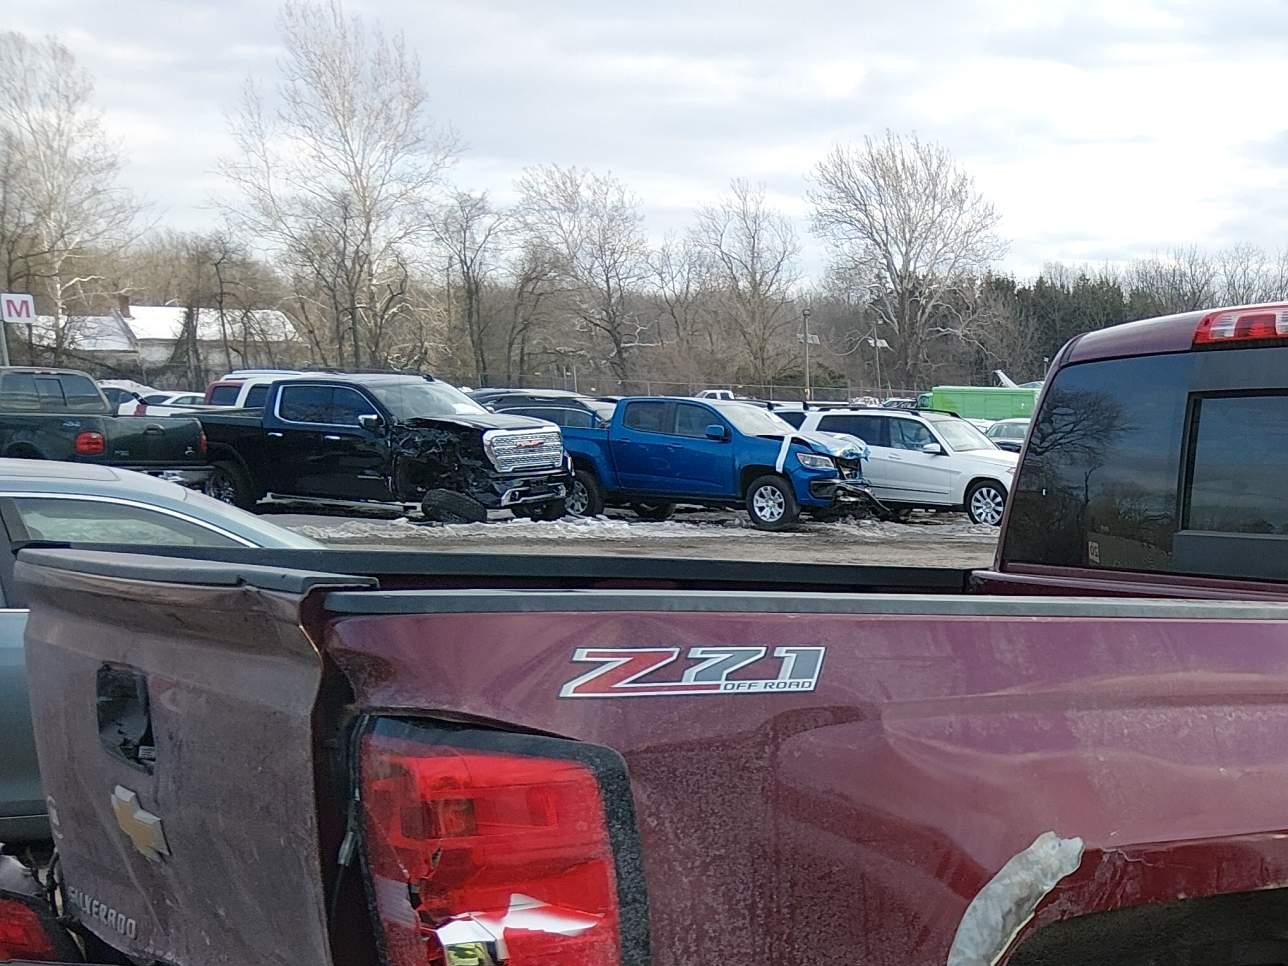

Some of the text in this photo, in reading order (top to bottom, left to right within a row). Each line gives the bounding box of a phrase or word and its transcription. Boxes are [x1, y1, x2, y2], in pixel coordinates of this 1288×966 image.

[5, 299, 31, 318] M
[558, 646, 825, 699] Z71
[723, 681, 813, 691] OFF ROAD
